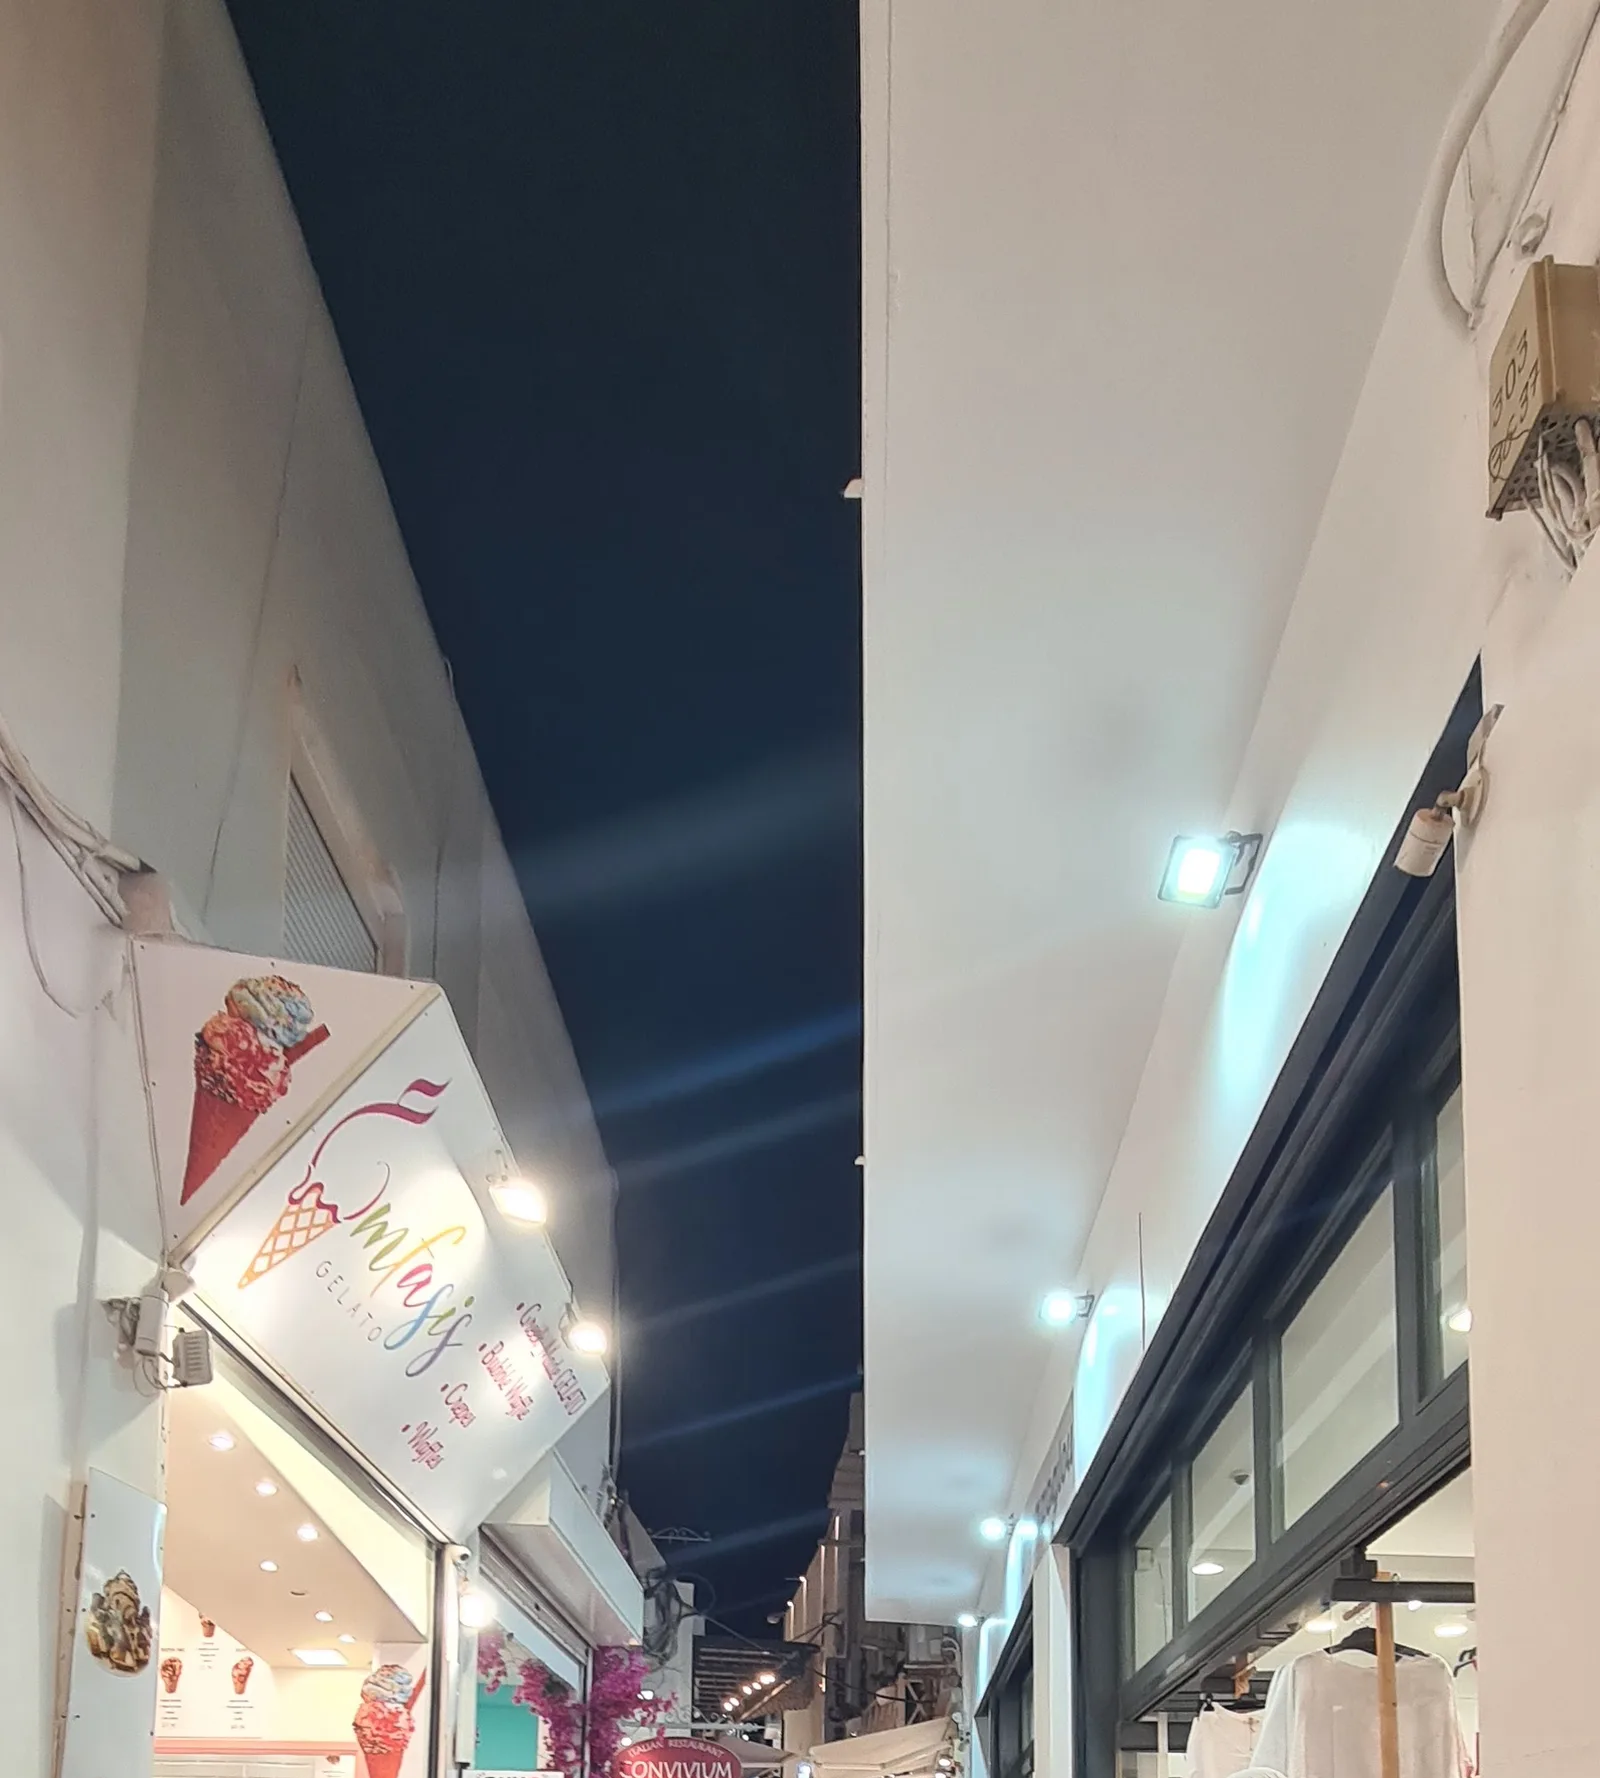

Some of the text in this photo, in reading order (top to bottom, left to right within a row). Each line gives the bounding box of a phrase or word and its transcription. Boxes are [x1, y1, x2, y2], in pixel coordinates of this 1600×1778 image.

[314, 1259, 384, 1343] GELATO
[481, 1340, 515, 1391] Bubble
[444, 1382, 476, 1428] Crepes
[552, 1367, 587, 1416] GELATO
[407, 1420, 444, 1470] Waffles
[627, 1739, 725, 1759] ITALIAN RESTAURANT
